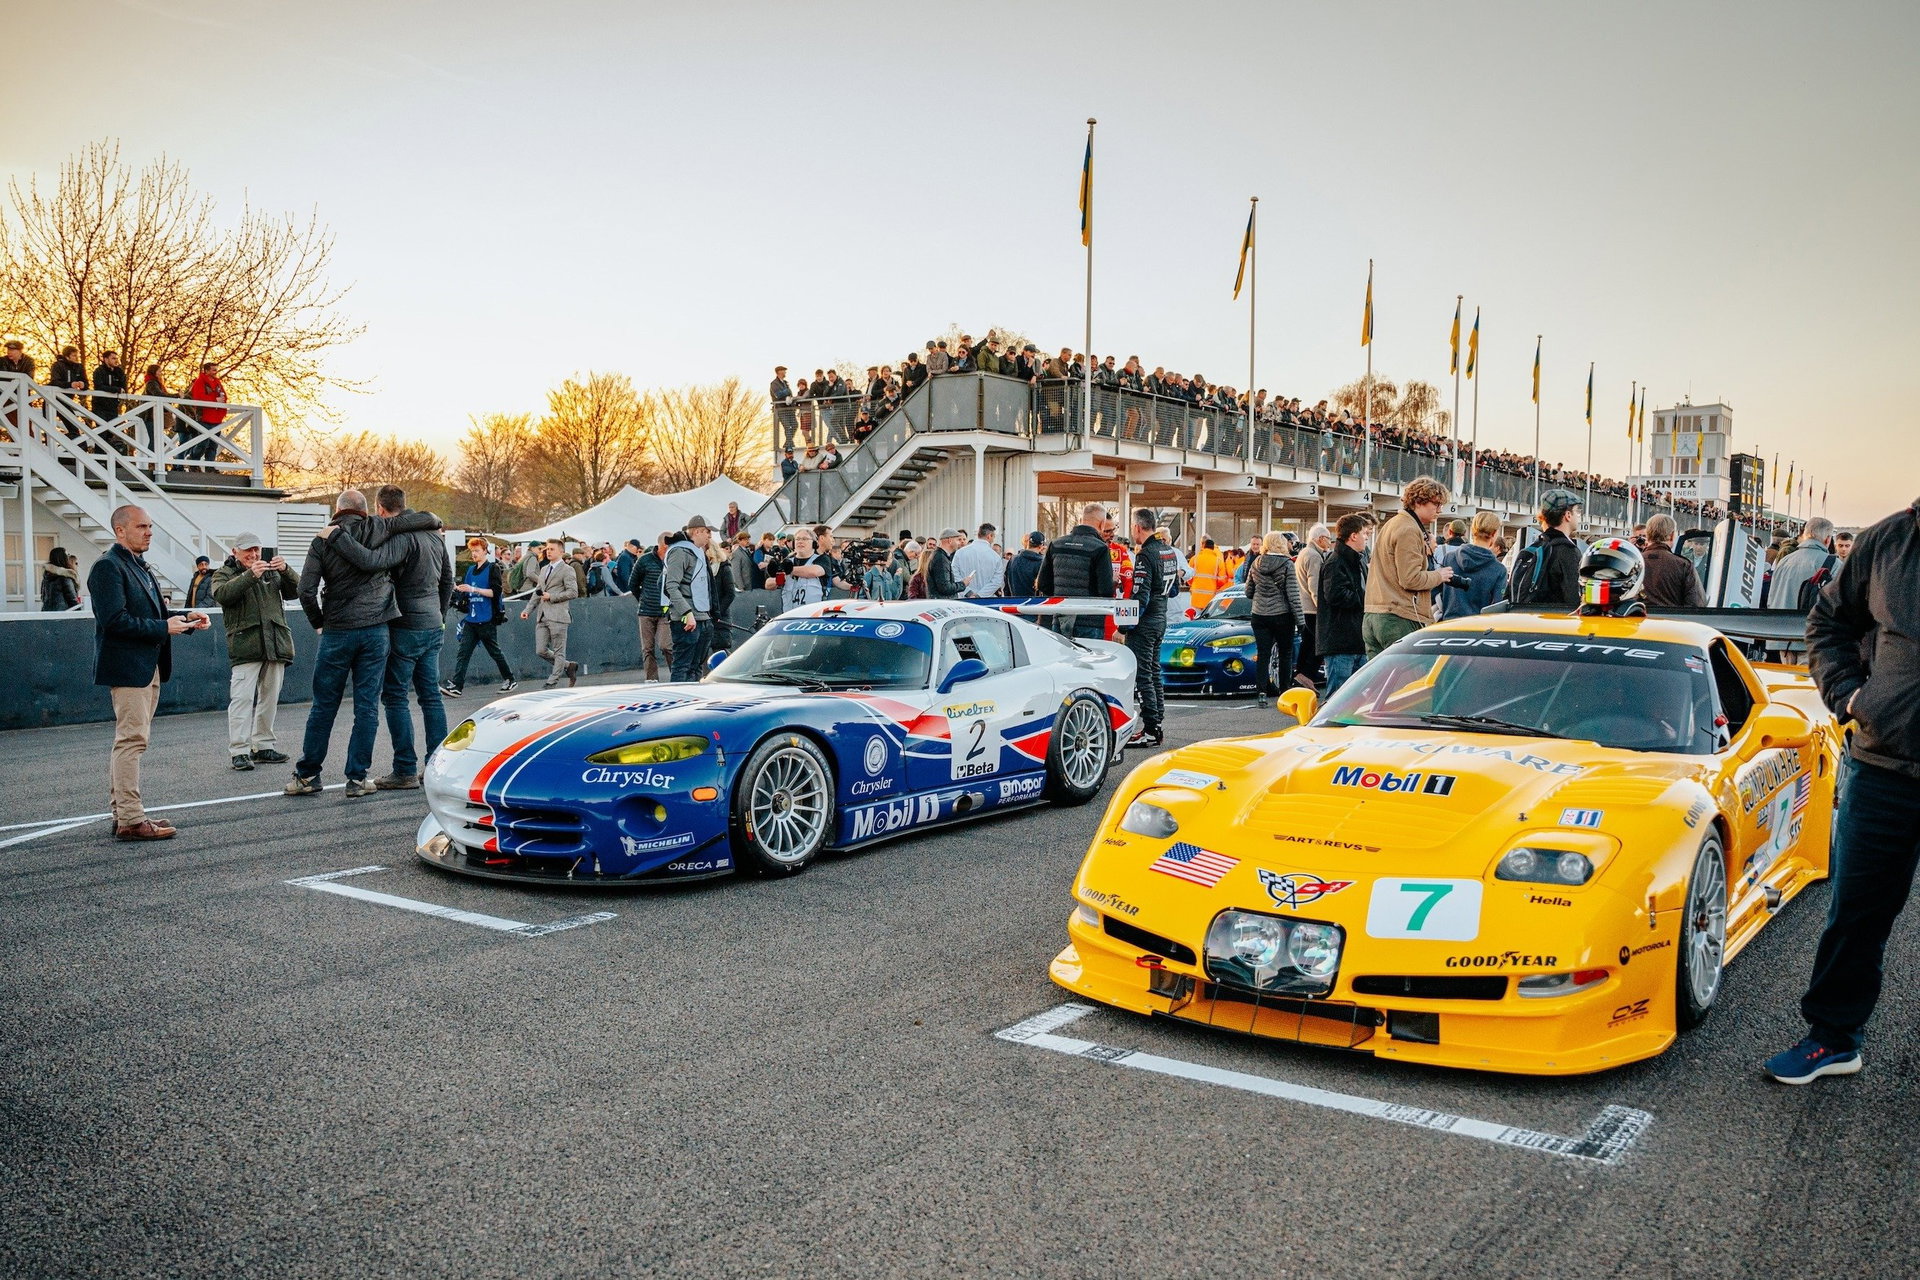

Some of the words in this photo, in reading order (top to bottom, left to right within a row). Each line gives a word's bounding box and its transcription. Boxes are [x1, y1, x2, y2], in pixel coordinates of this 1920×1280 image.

[1174, 465, 1180, 477] 1
[1246, 476, 1254, 486] 2
[1646, 480, 1697, 488] MINTEX
[1309, 485, 1316, 495] 3
[1363, 493, 1370, 502] 4
[1450, 504, 1456, 512] 6
[792, 588, 806, 606] 42
[1116, 607, 1131, 616] Mobil
[782, 620, 864, 634] Chrysler
[1412, 637, 1665, 660] CORVETTE
[966, 719, 986, 761] 2
[966, 762, 994, 777] Beta
[582, 768, 675, 789] Chrysler
[1332, 765, 1421, 793] Mobil
[852, 777, 893, 796] Chrysler
[851, 798, 915, 841] Mobil
[637, 835, 691, 851] MICHELIN
[1102, 837, 1128, 848] Hella
[668, 861, 713, 871] ORECA
[1399, 883, 1454, 932] 7
[1529, 895, 1573, 908] Hella
[1631, 939, 1671, 956] MOTOROLA
[1612, 998, 1650, 1020] OZ
